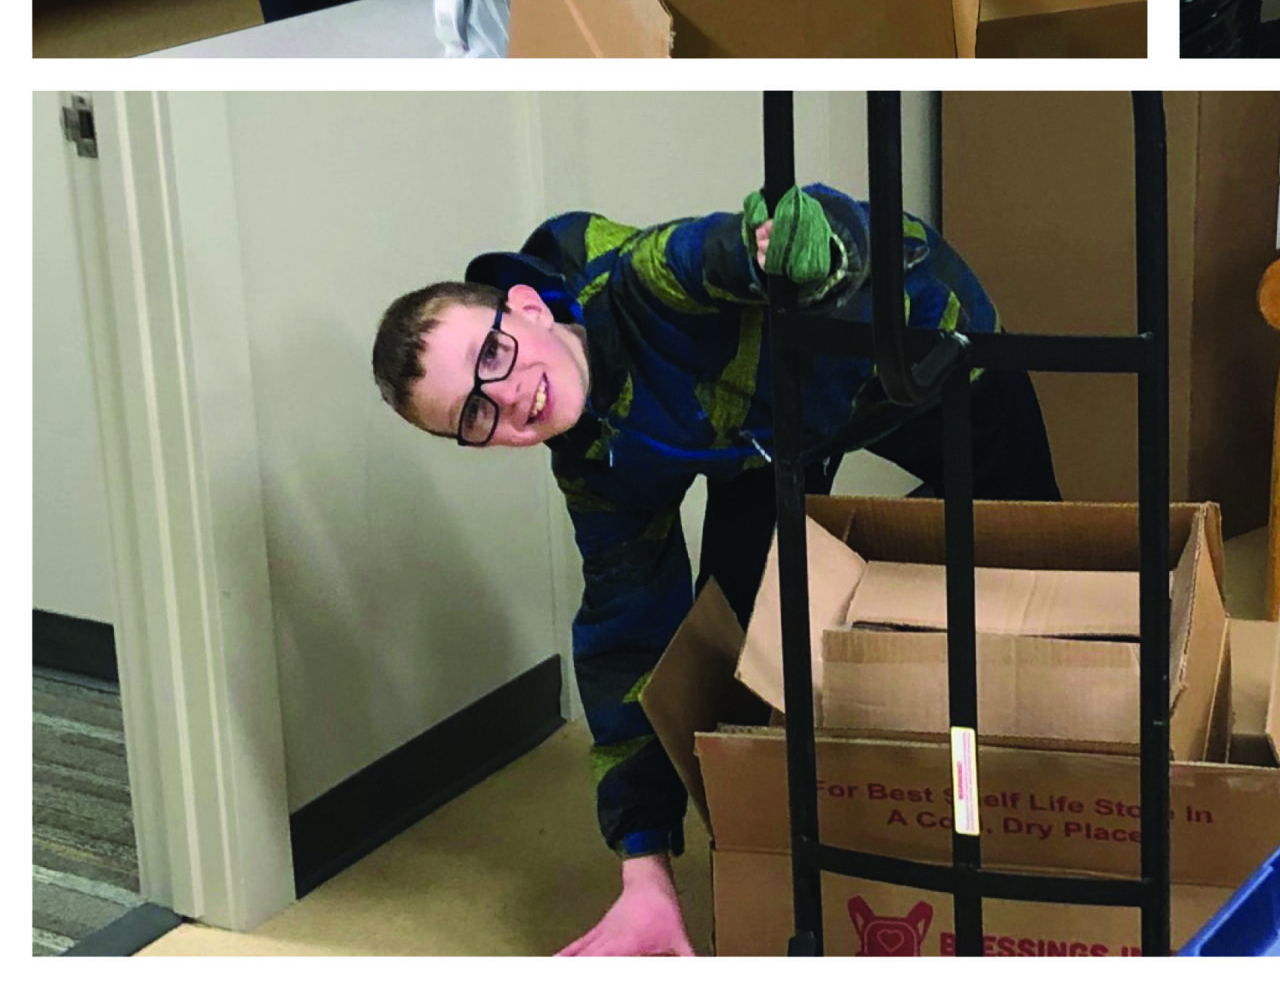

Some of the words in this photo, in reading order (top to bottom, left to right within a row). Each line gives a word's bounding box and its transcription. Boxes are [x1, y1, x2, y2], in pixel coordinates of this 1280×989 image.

[867, 783, 933, 803] Best
[1030, 794, 1084, 814] Life
[1185, 805, 1213, 824] In
[887, 810, 908, 826] A
[1003, 819, 1053, 840] Dry
